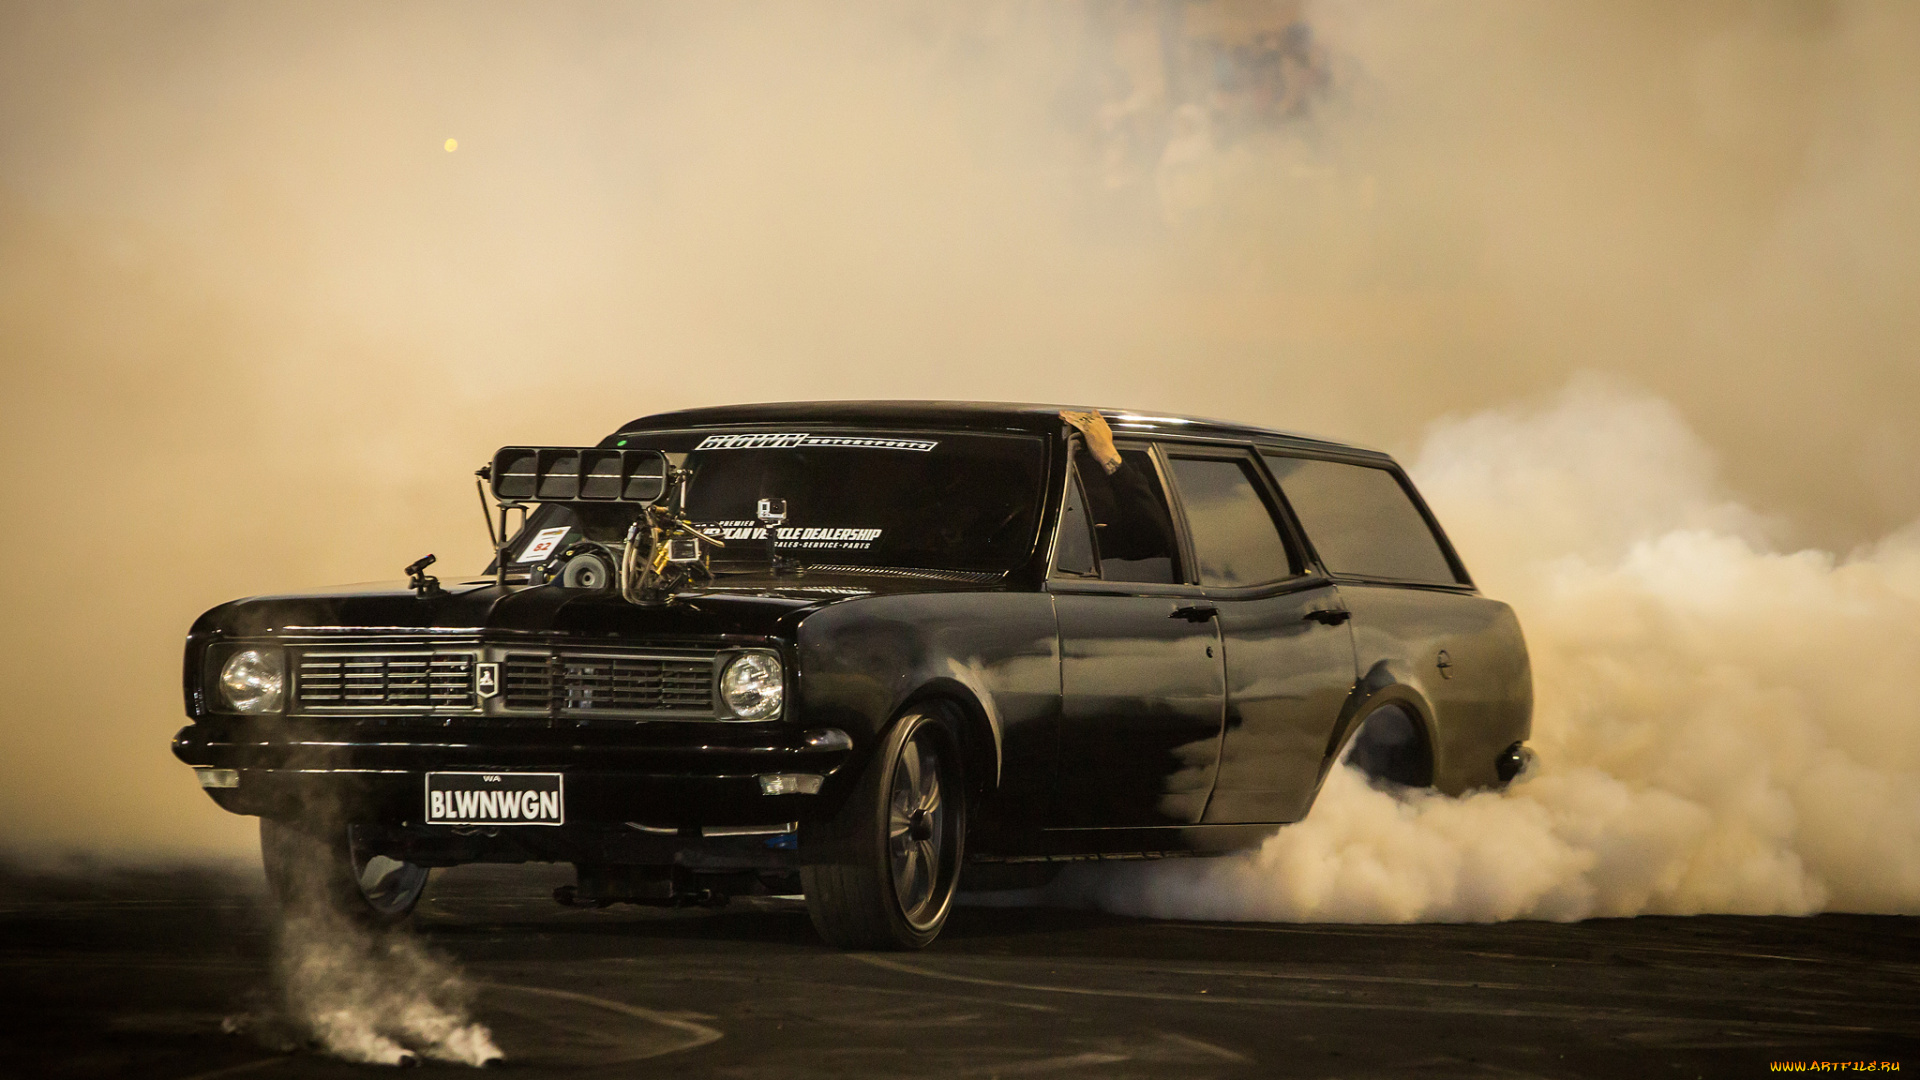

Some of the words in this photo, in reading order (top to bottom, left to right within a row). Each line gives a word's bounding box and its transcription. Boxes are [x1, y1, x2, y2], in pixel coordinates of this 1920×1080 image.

[807, 438, 930, 449] MOTORSPORTS
[751, 528, 804, 540] VEICLE
[801, 528, 882, 541] DEALERSHIP
[430, 790, 559, 819] BLWNWGN
